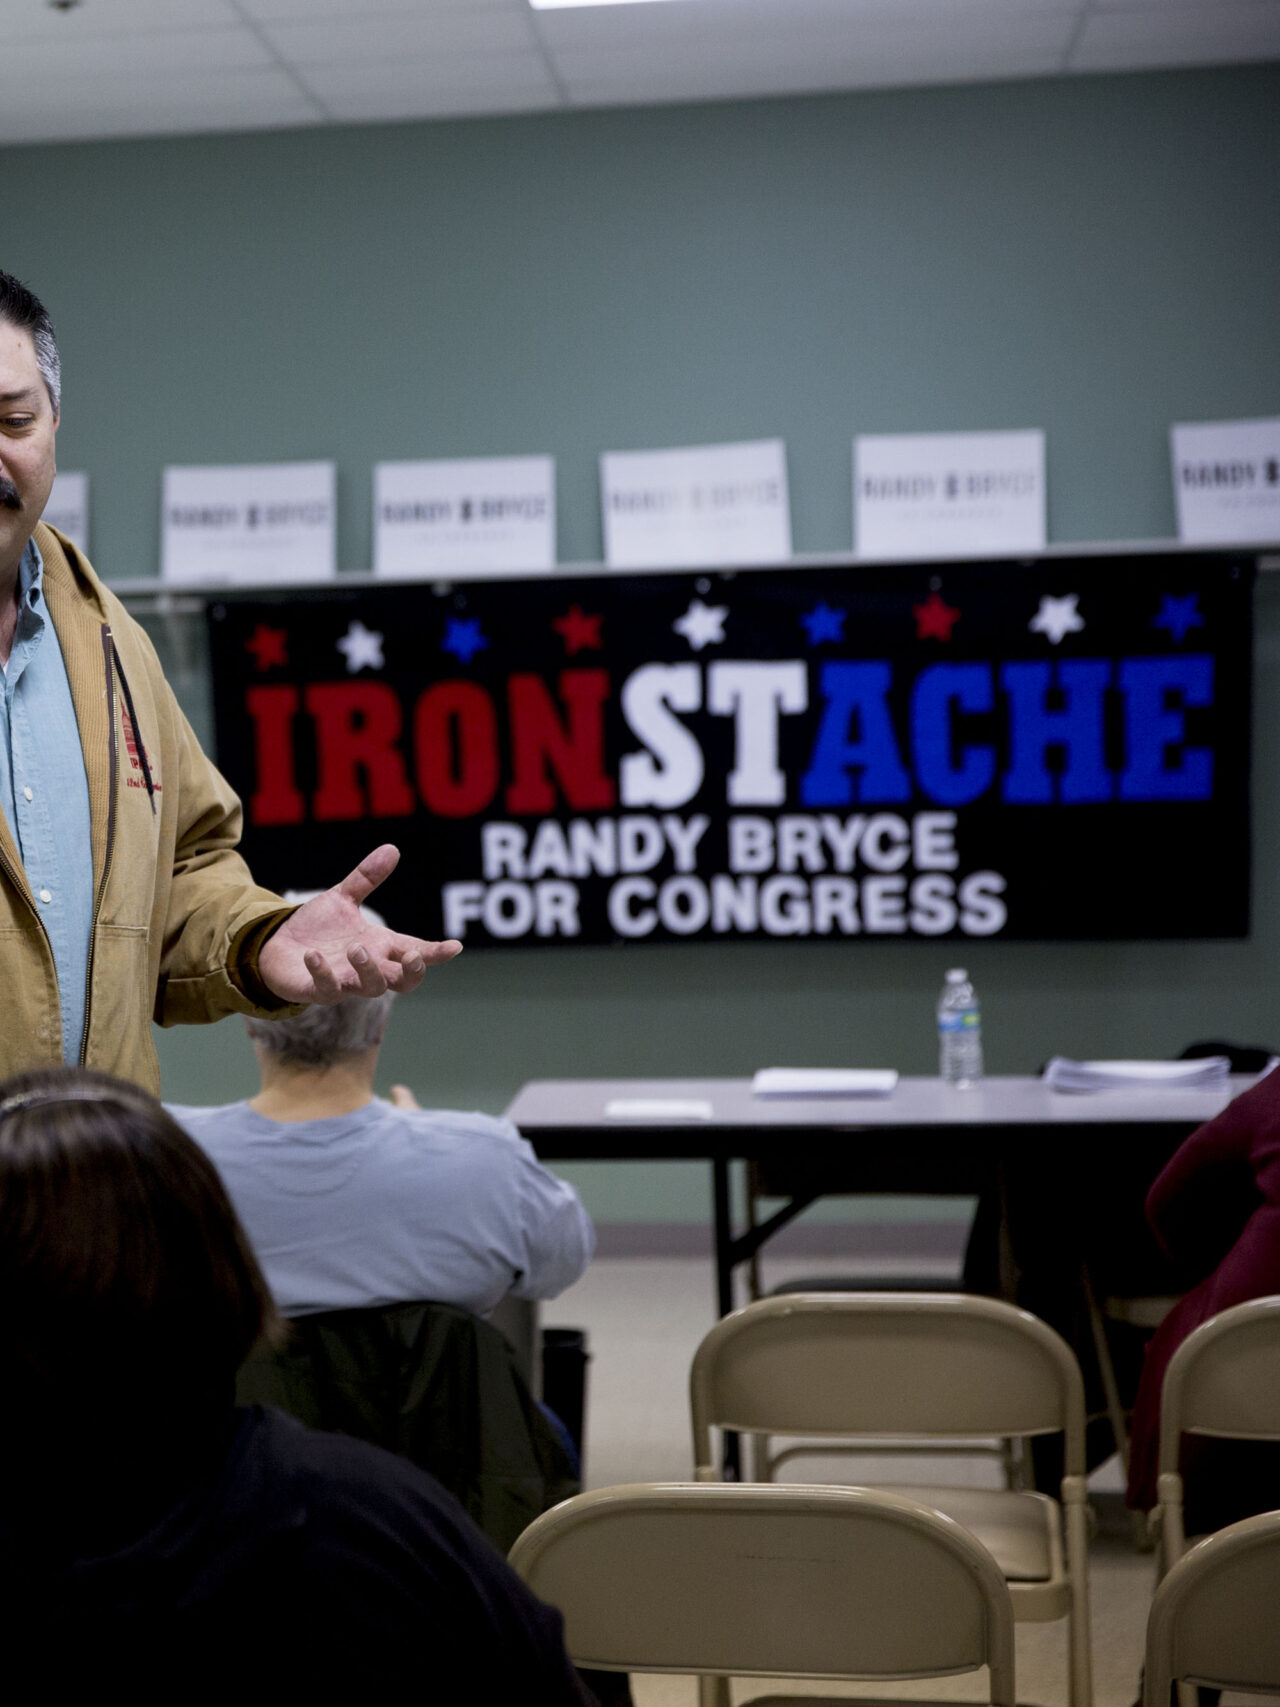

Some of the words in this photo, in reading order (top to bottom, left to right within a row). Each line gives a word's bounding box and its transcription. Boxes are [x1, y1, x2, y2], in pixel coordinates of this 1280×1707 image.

[246, 653, 1214, 826] IRONSTACHE
[481, 813, 708, 880] RANDY
[728, 810, 959, 874] BRYCE
[441, 880, 581, 940] FOR
[607, 869, 1008, 938] CONGRESS
